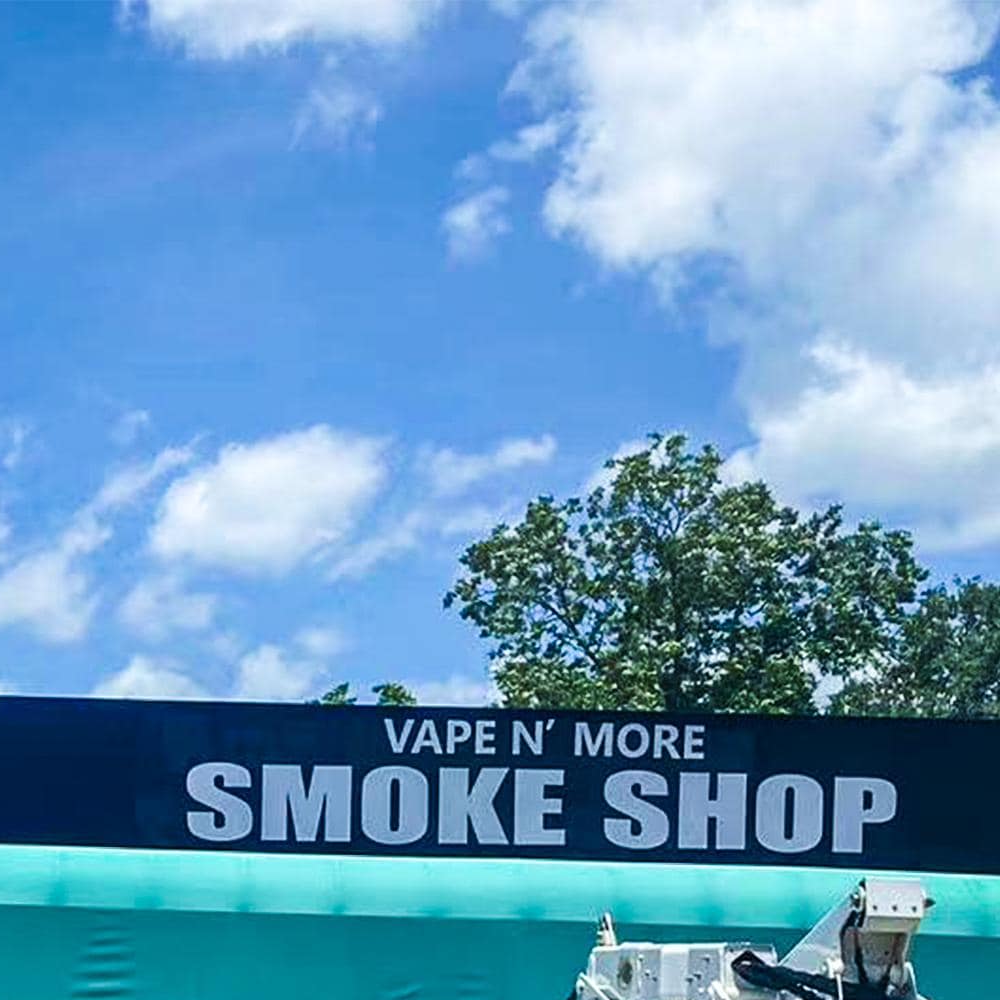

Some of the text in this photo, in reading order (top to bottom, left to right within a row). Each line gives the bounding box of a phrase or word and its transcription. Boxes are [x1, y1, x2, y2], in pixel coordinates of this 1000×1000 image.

[384, 718, 496, 756] VAPE
[574, 721, 706, 761] MORE
[185, 762, 897, 854] SMOKE SHOP
